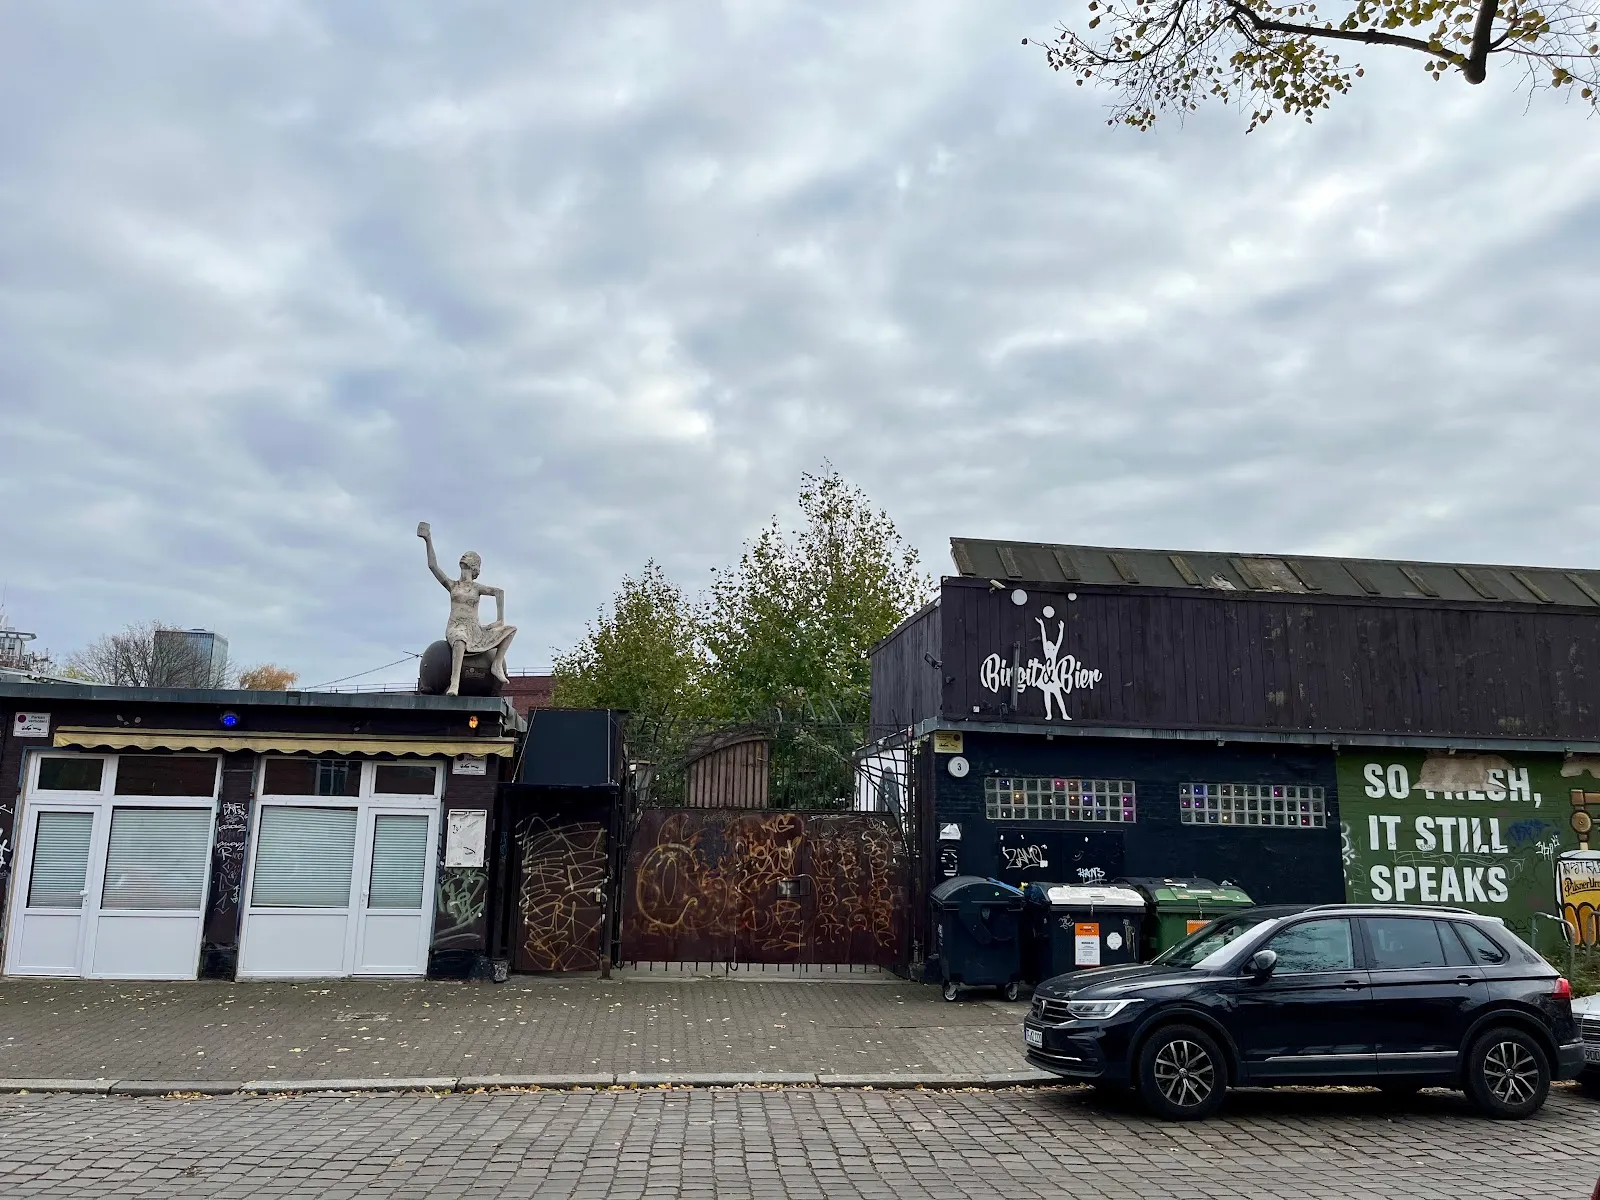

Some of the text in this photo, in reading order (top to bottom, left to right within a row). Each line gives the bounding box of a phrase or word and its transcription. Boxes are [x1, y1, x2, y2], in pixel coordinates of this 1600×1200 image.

[980, 653, 1046, 693] Birgit
[1056, 654, 1103, 694] Bier
[957, 762, 962, 771] 3
[1363, 763, 1542, 809] SO SH,
[1368, 815, 1402, 851] IT
[1415, 815, 1509, 854] STILL
[1370, 865, 1509, 903] SPEAKS
[1564, 877, 1589, 897] Pilsner
